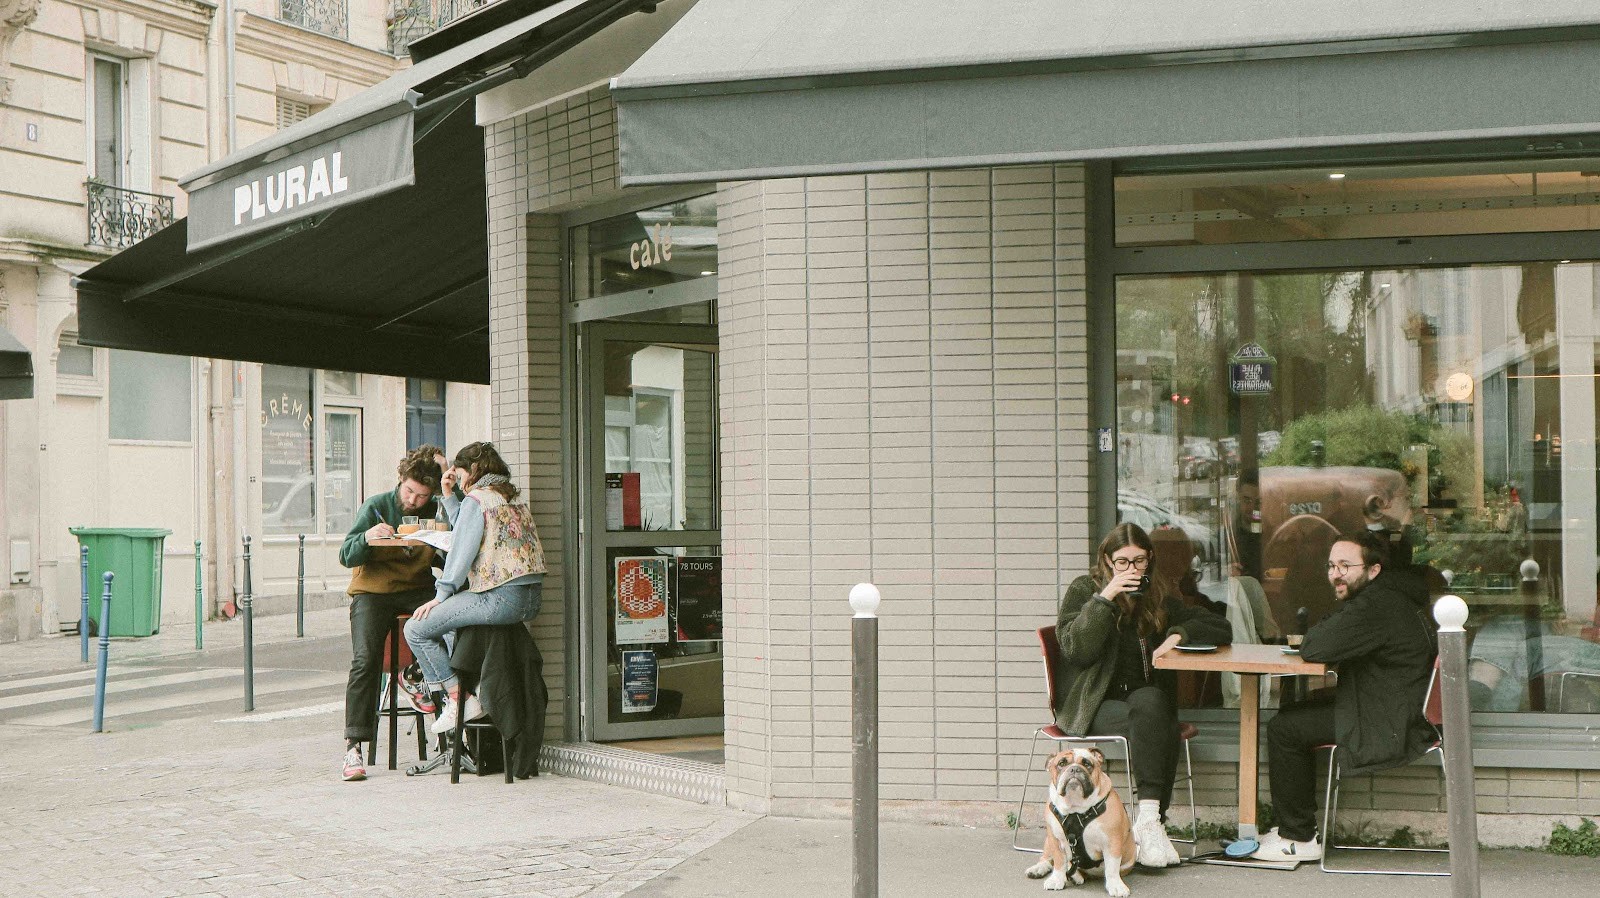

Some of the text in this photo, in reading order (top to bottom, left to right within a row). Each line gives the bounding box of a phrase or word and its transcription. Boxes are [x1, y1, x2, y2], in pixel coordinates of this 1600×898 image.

[28, 124, 36, 141] 8
[234, 151, 348, 226] PLURAL
[630, 221, 672, 270] café
[680, 562, 714, 571] 78 TOURS
